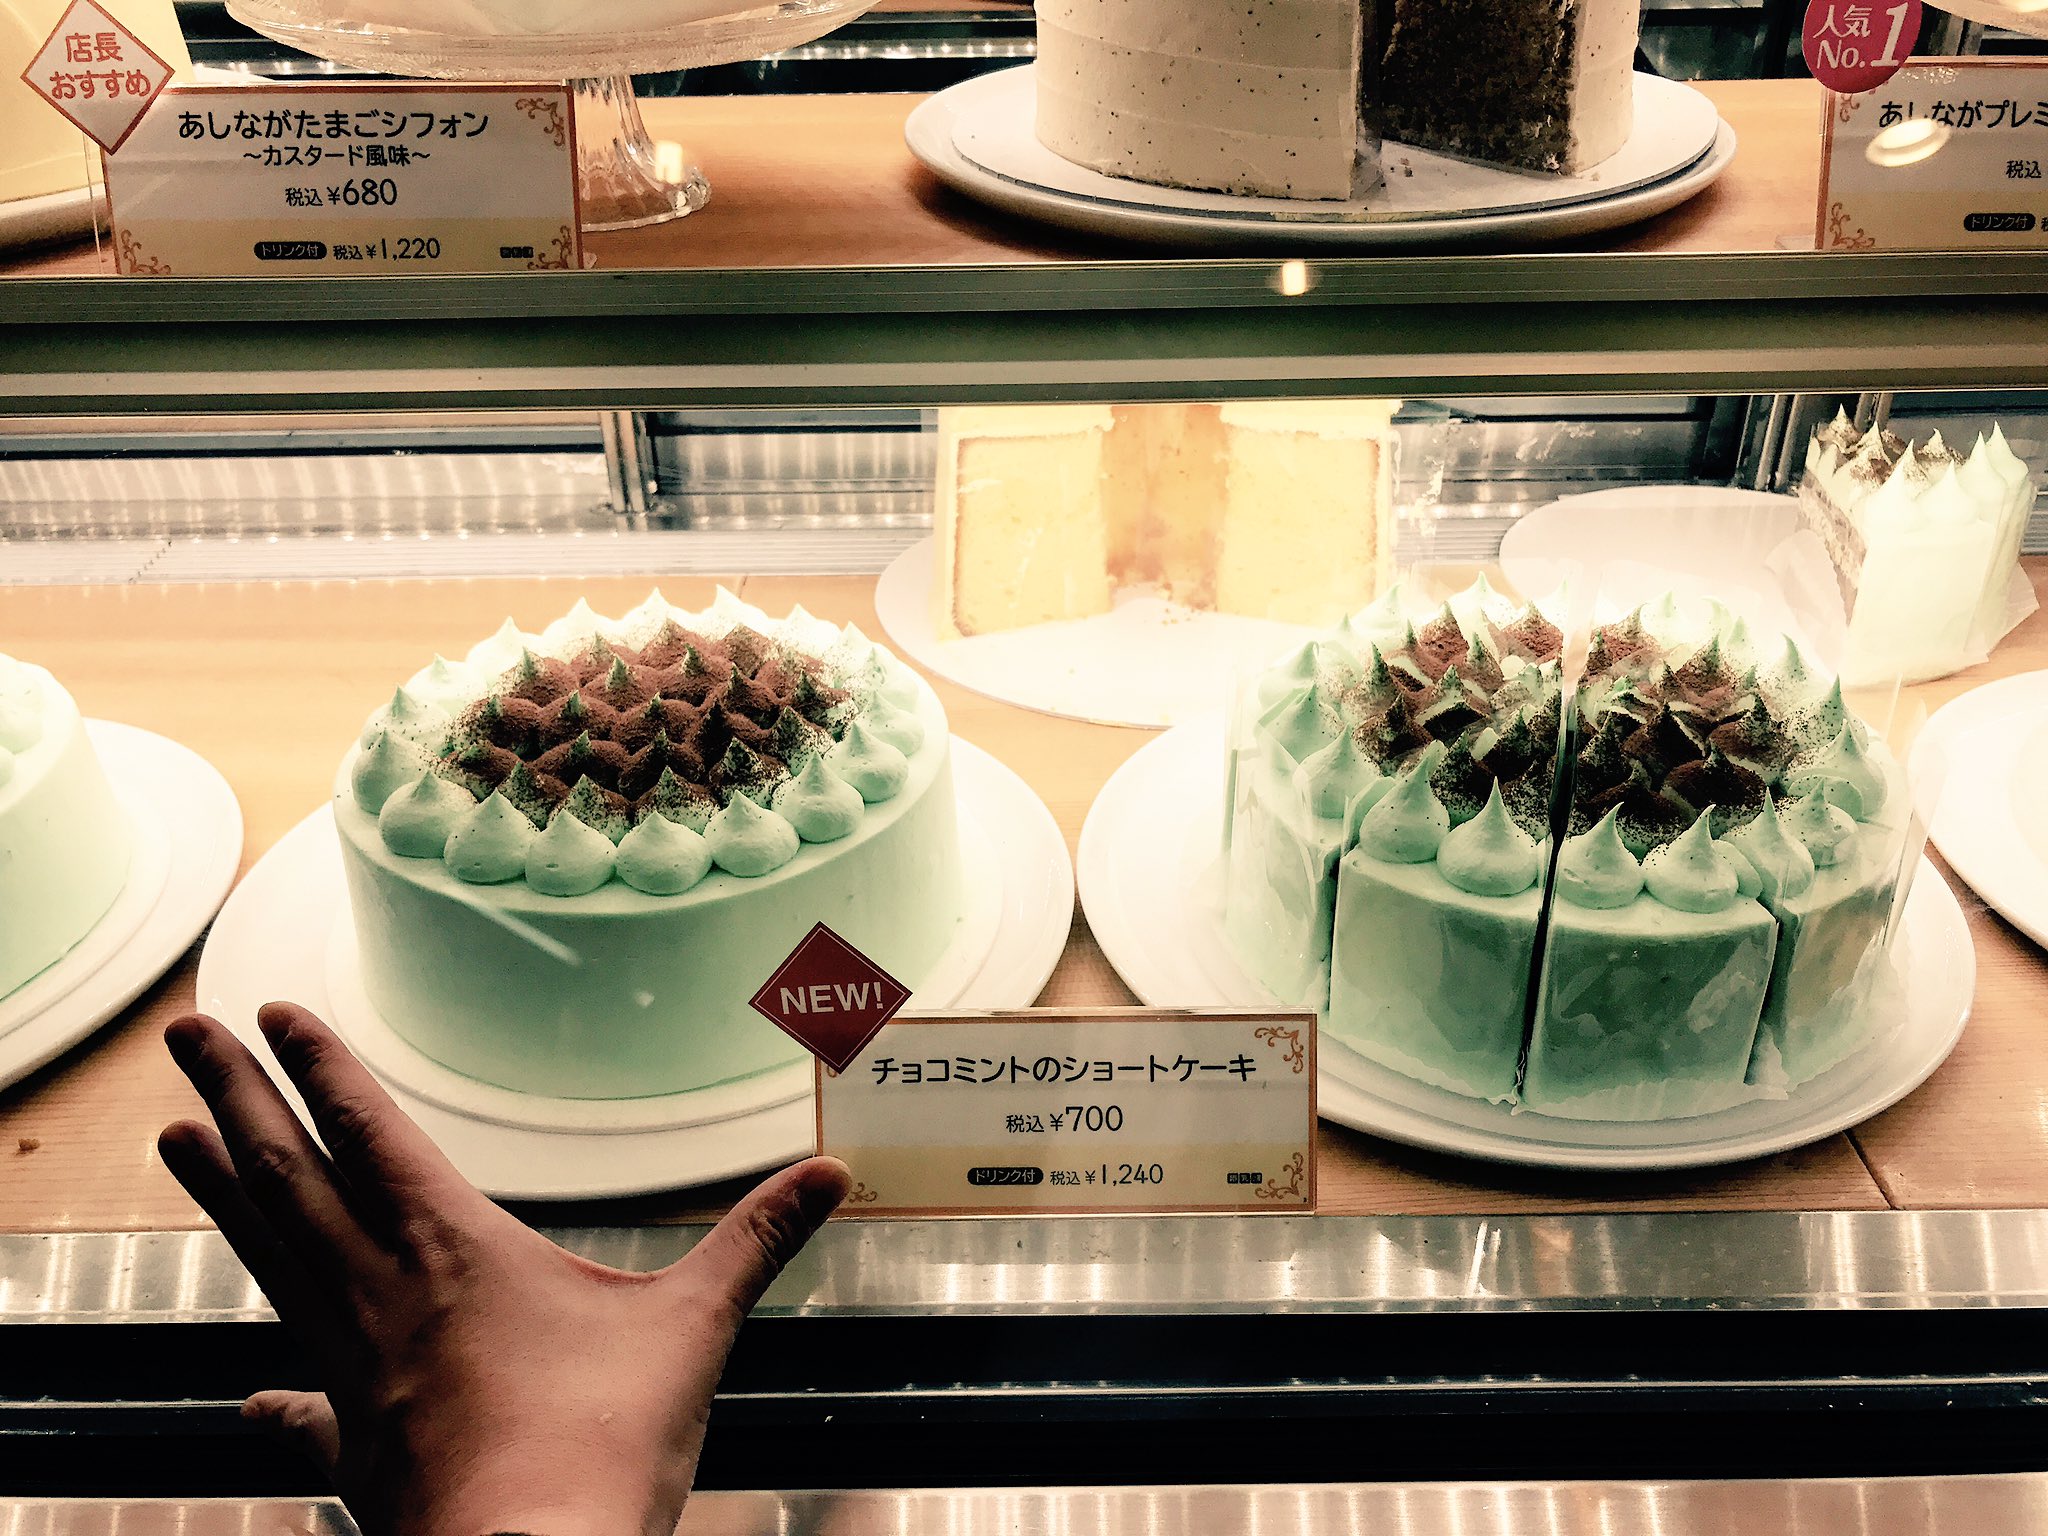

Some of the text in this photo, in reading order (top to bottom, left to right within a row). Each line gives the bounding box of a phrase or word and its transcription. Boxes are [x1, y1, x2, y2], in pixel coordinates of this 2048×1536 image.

[1813, 5, 1872, 38] 人気
[67, 32, 124, 64] 店長
[49, 69, 152, 100] おすすめ
[178, 109, 489, 140] あしながたまごシフォン
[2005, 160, 2043, 179] 税込
[285, 178, 398, 207] 税込 ¥680
[333, 244, 363, 260] 税込
[366, 237, 441, 261] ¥1,220
[780, 982, 884, 1016] NEW!
[871, 1053, 1257, 1085] チョコミントのショートケーキ
[1006, 1105, 1123, 1134] 税込 ¥700
[974, 1163, 1164, 1187] ドリンク付 税込 ¥1,240
